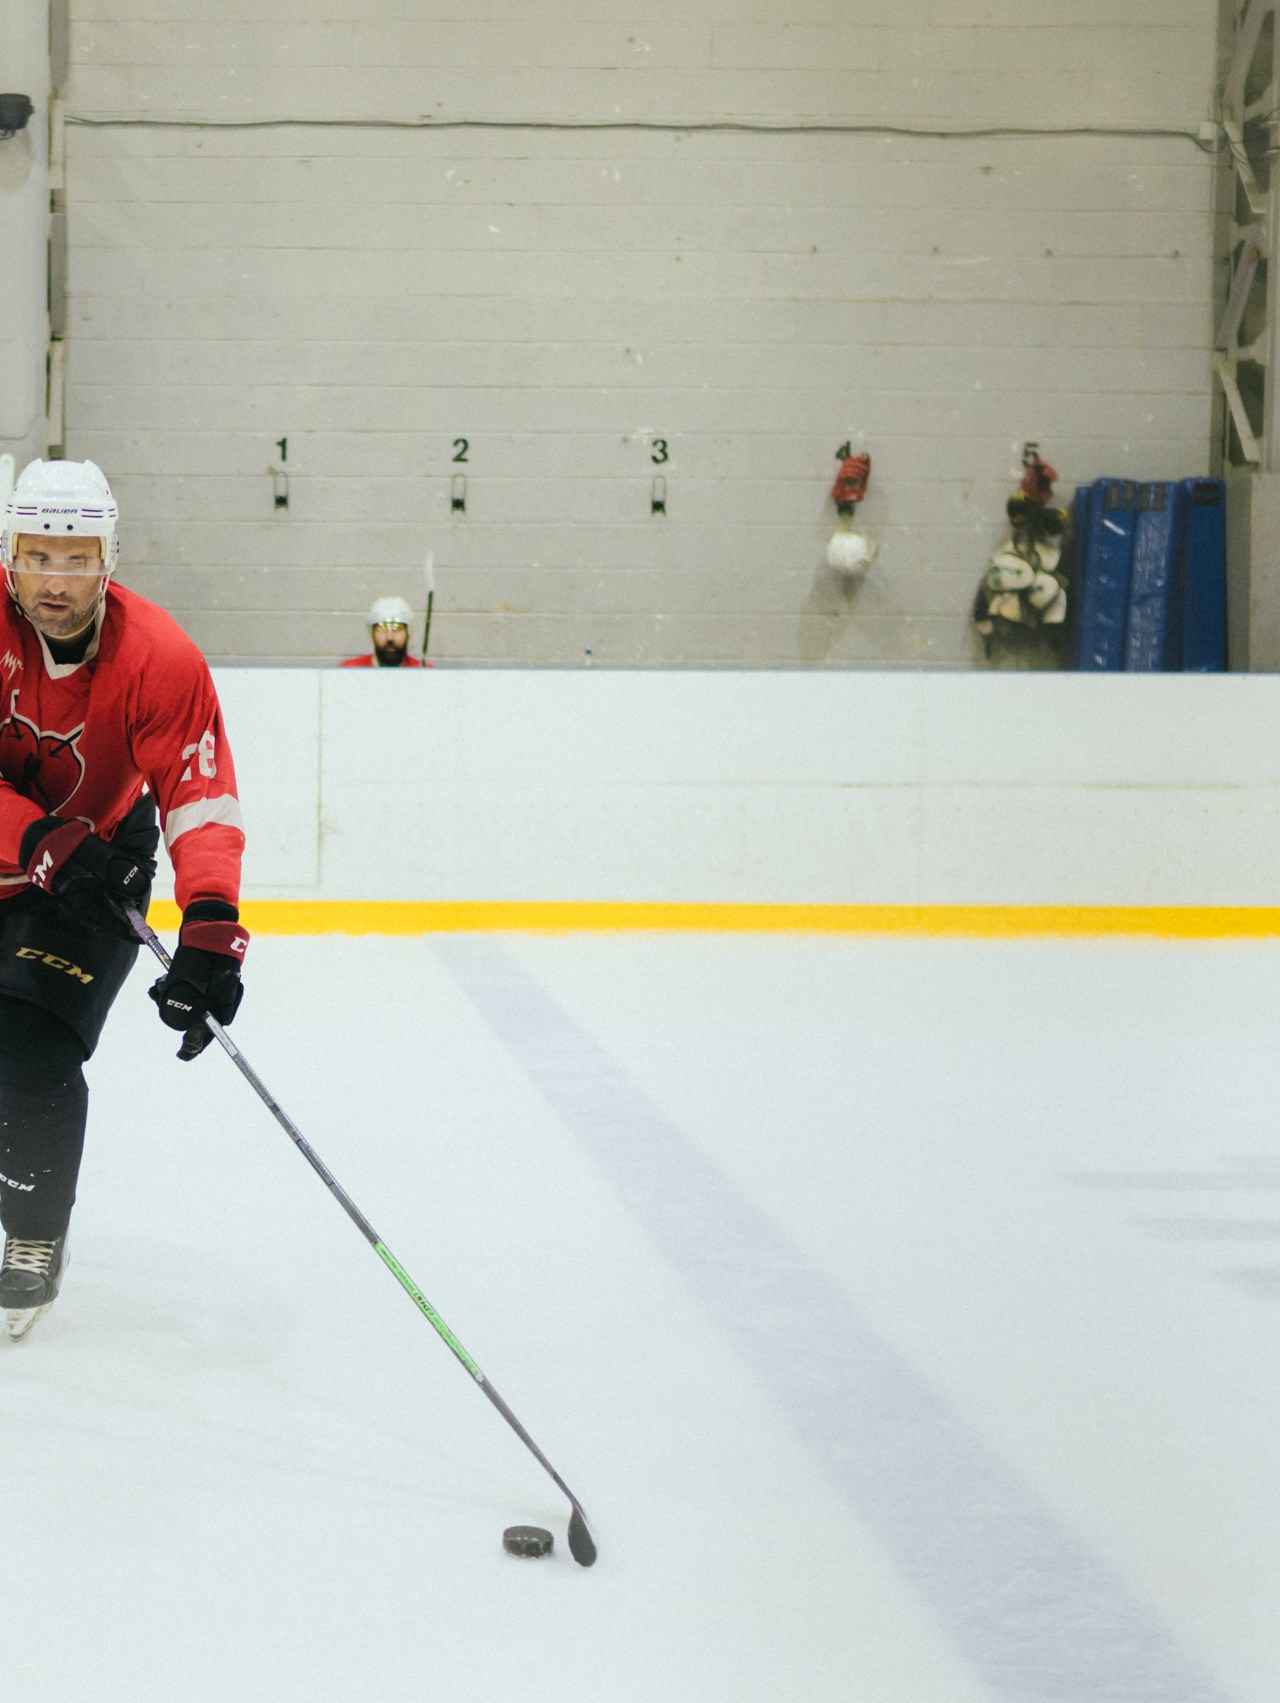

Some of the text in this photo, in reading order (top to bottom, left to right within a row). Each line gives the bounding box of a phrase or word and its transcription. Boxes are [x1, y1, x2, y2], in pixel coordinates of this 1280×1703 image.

[276, 438, 287, 462] 1
[452, 438, 469, 463] 2
[651, 439, 669, 464] 3
[41, 508, 78, 516] BAUER
[15, 947, 94, 985] CCM
[166, 999, 193, 1012] CCM
[0, 1172, 36, 1192] CCM
